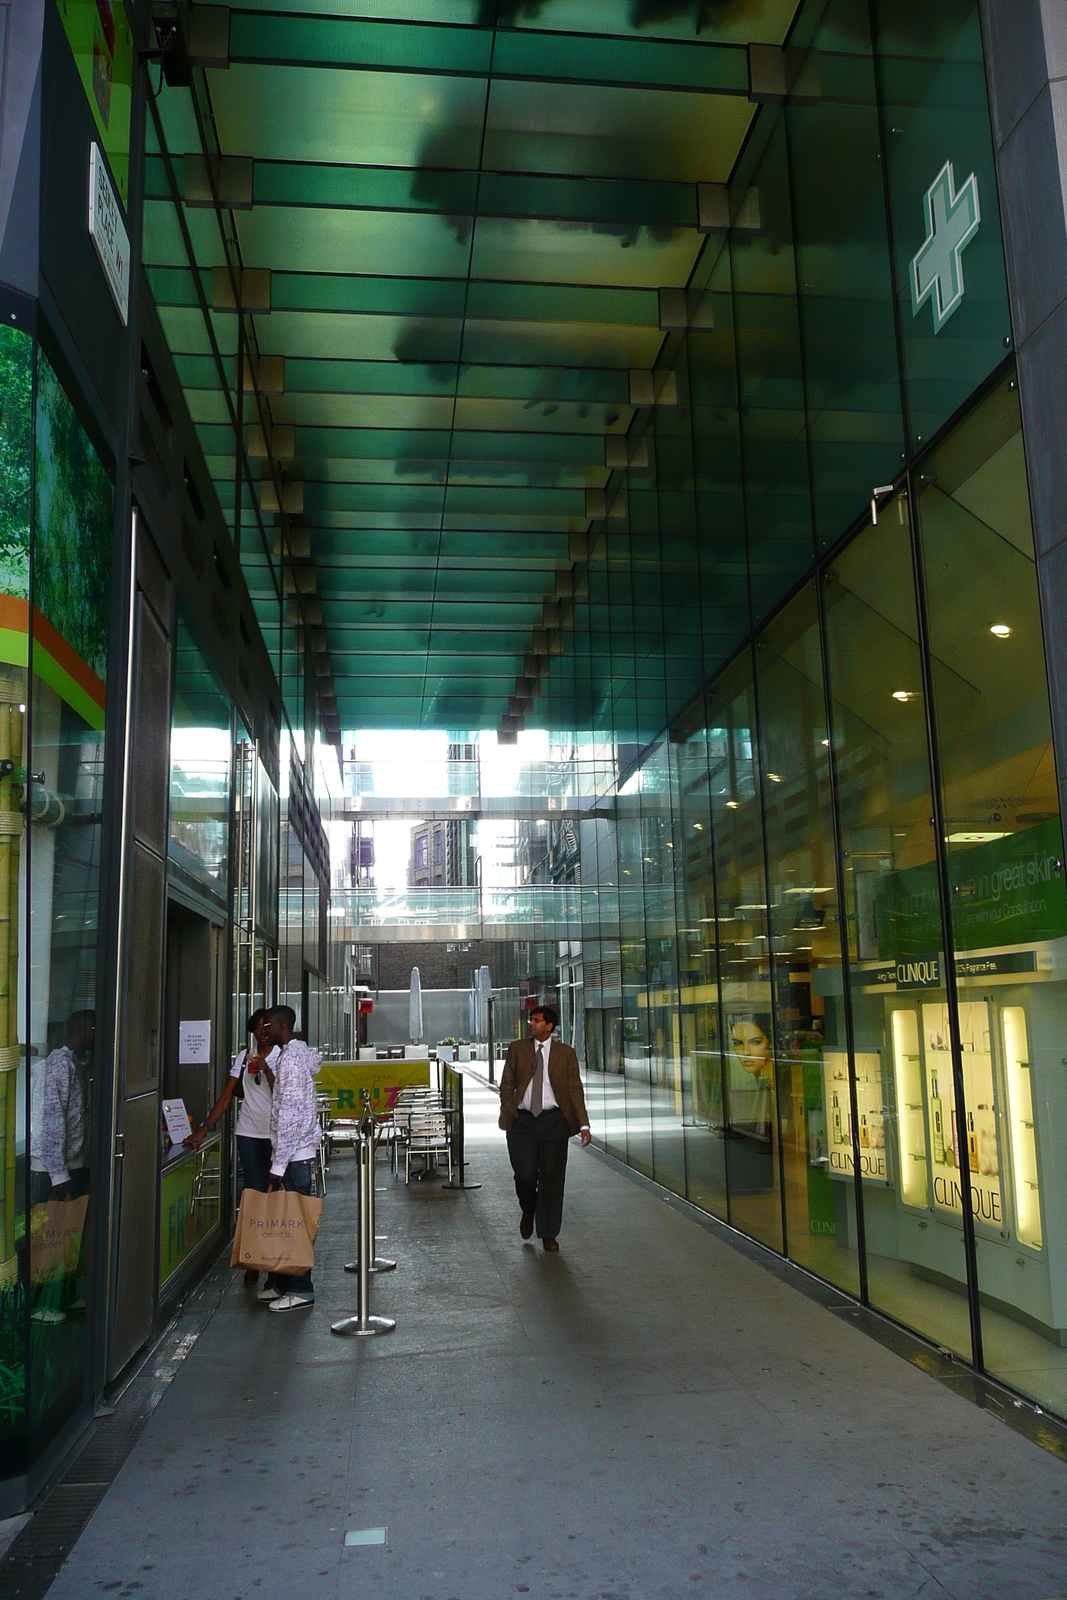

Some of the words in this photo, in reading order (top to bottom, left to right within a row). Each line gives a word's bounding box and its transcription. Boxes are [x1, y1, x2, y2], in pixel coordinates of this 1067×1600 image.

[98, 165, 119, 232] SEDLEY
[98, 196, 114, 254] PLACE
[991, 860, 1026, 901] great
[896, 960, 938, 984] CLINIQUE
[829, 1151, 886, 1177] CLINQUE
[934, 1176, 1002, 1222] CLINQUE
[250, 1218, 304, 1229] PRIMARK
